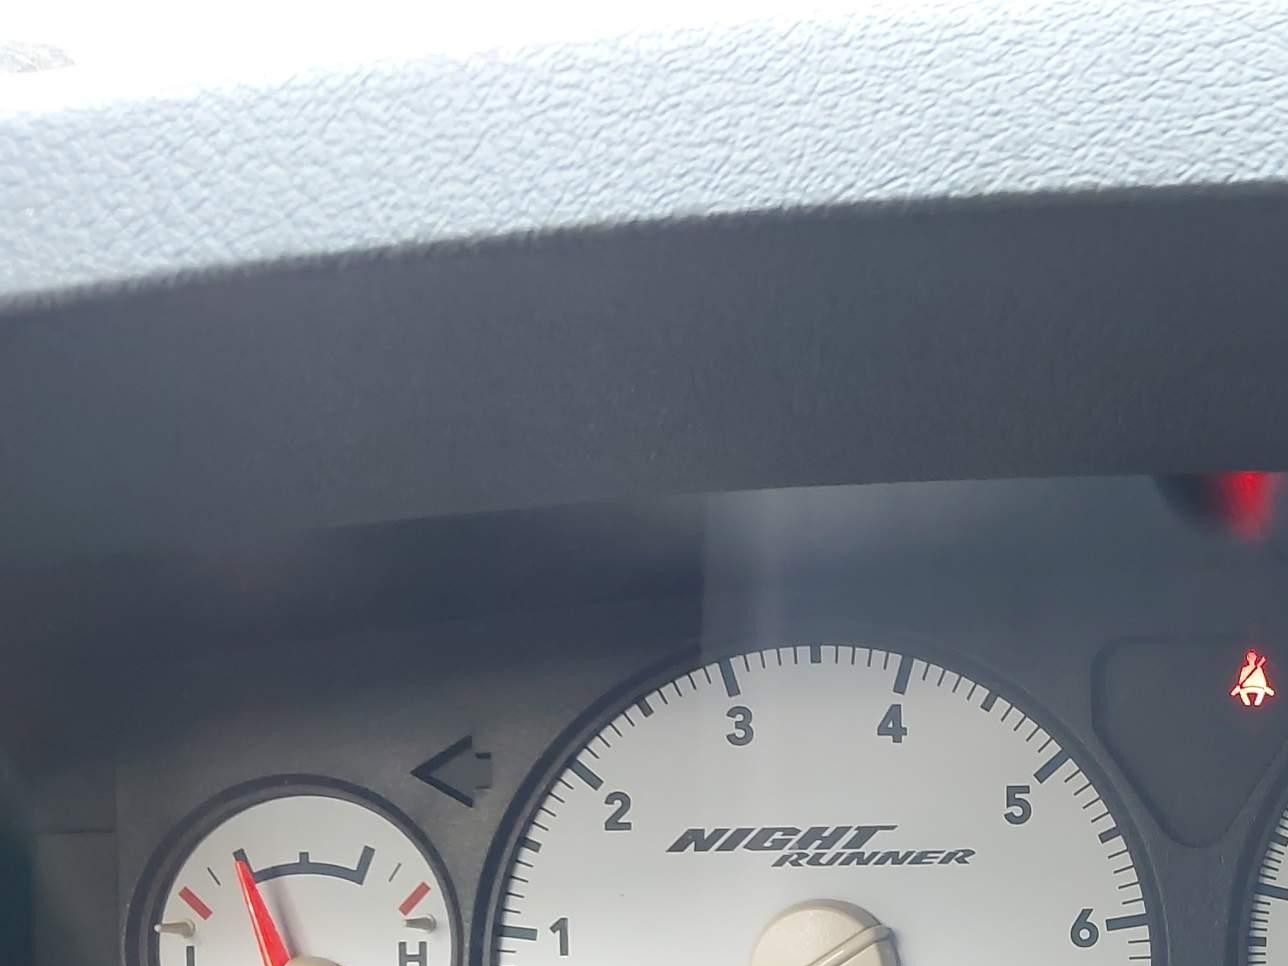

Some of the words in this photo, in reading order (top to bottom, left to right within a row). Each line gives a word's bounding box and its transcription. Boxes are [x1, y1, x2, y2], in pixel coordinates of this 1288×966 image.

[726, 706, 753, 746] 3
[877, 704, 907, 743] 4
[605, 791, 631, 831] 2
[1004, 785, 1031, 825] 5
[666, 824, 899, 852] NIGHT
[771, 848, 975, 867] RUNNER
[550, 918, 568, 956] 1
[1071, 909, 1099, 947] 6
